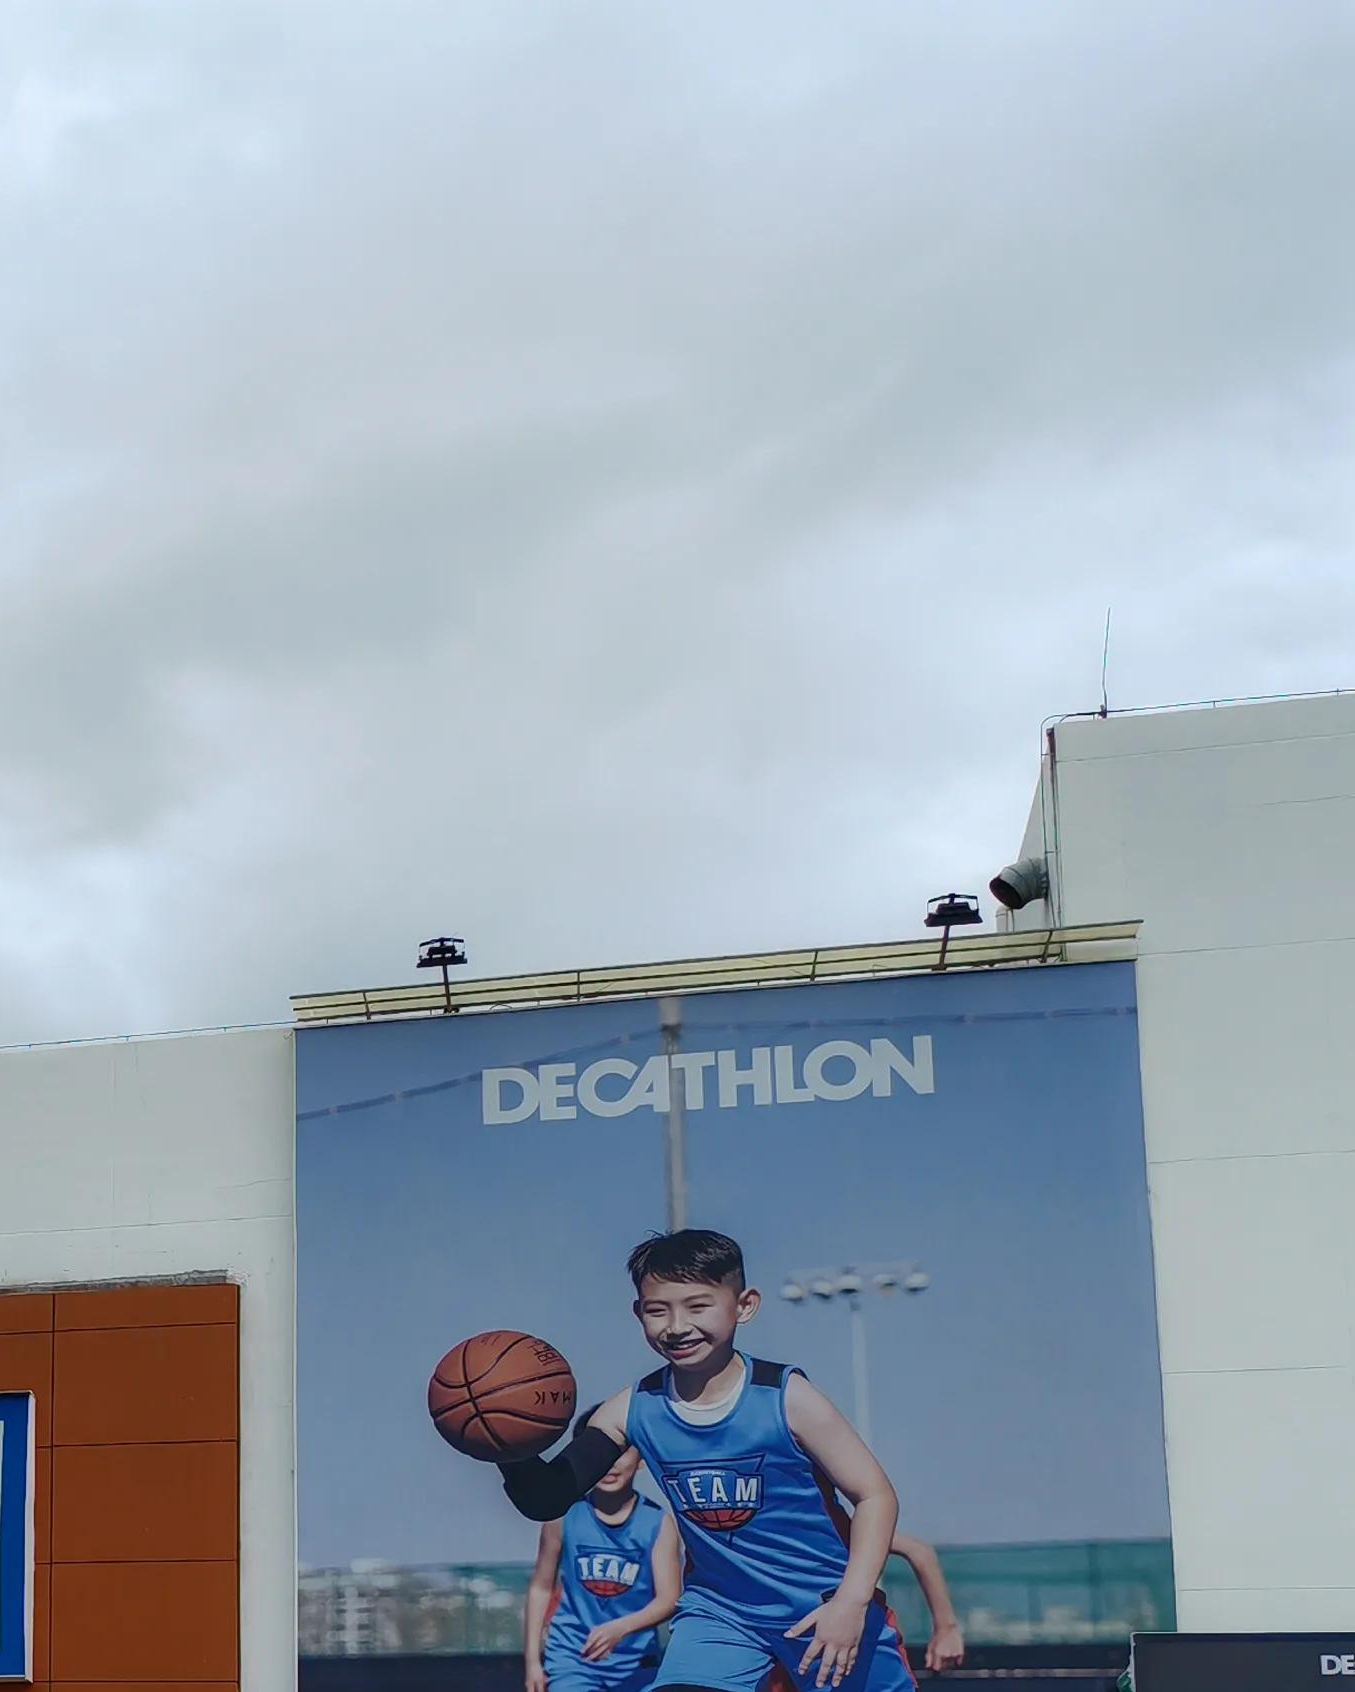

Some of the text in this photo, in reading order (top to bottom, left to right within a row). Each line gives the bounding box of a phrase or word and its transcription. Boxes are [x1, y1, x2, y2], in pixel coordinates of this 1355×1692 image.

[482, 1035, 935, 1125] DECATHLON
[667, 1476, 758, 1503] TEAM
[577, 1556, 640, 1586] TEAM
